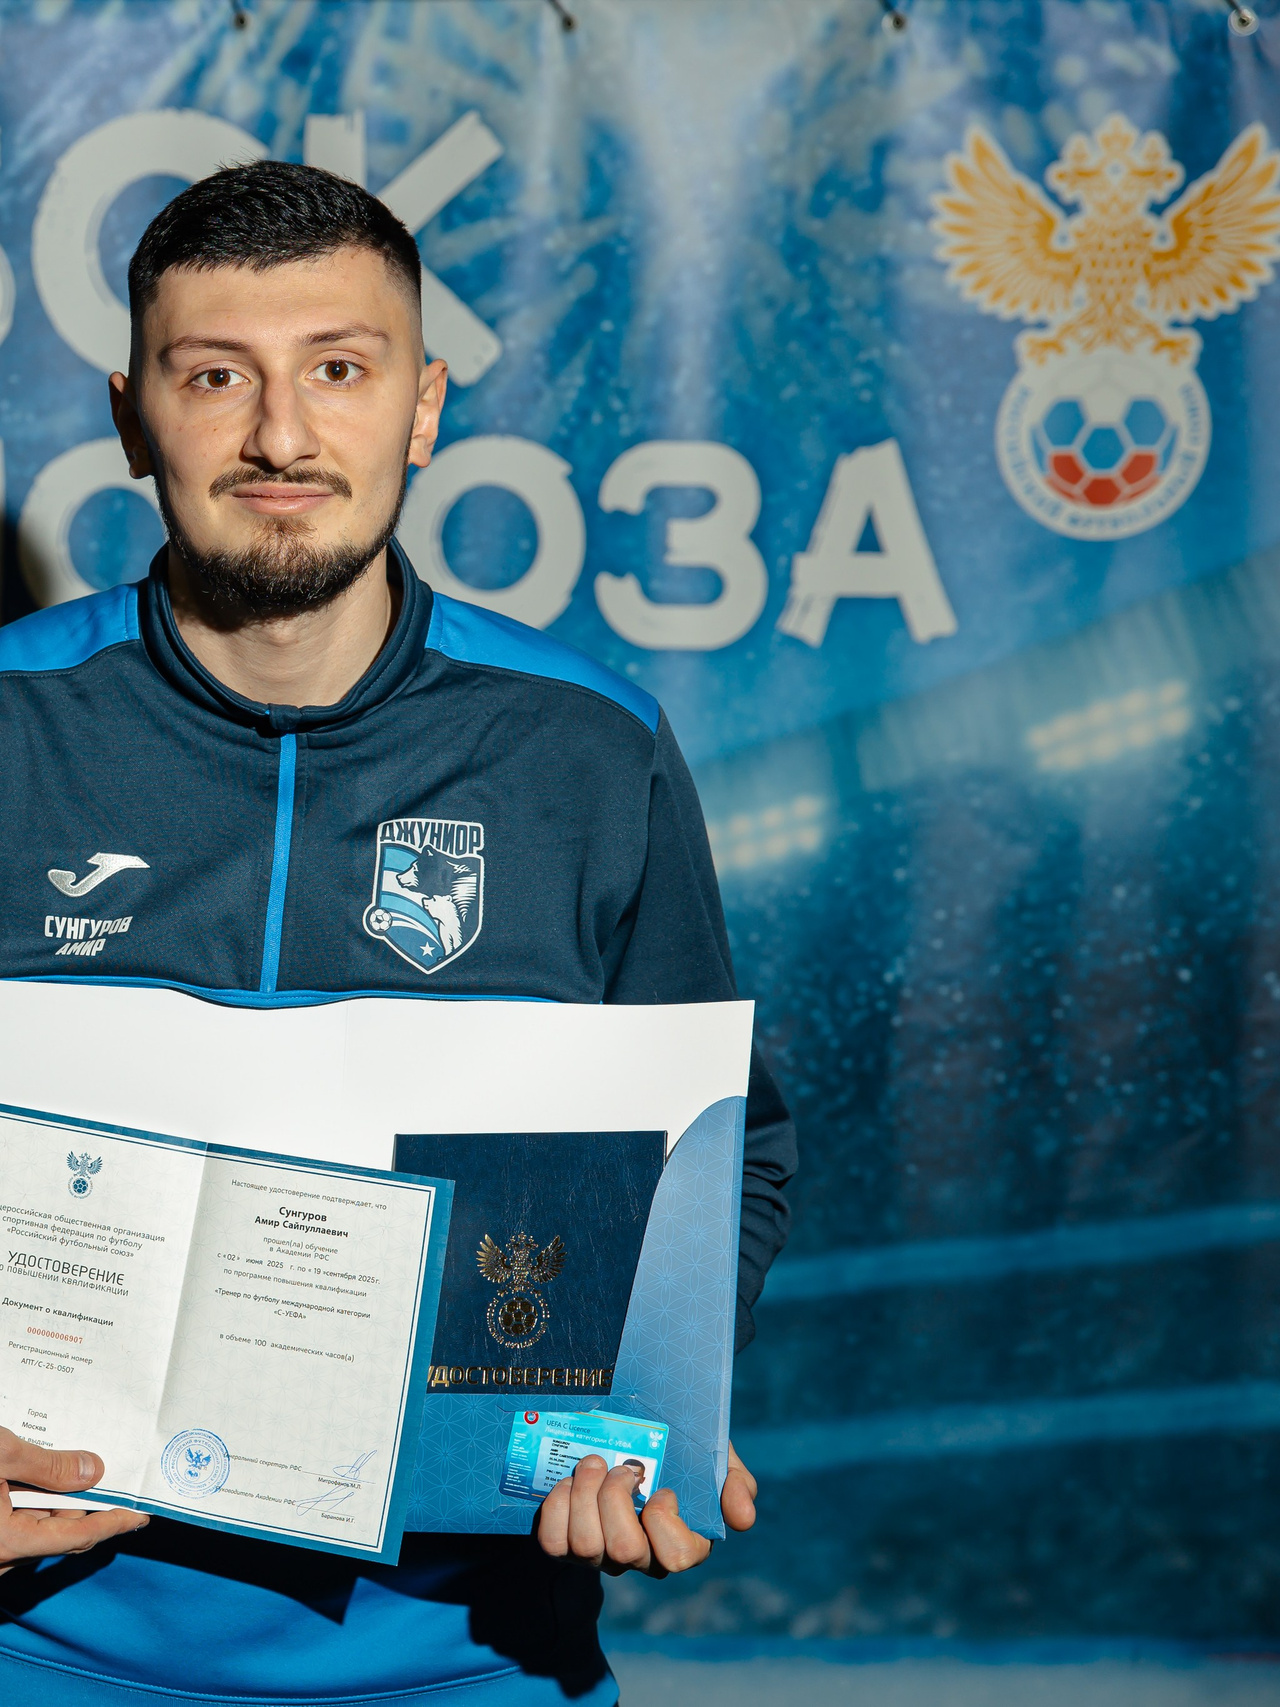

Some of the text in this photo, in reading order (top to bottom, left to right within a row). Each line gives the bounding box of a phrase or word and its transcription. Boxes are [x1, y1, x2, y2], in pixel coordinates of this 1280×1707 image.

[380, 821, 481, 857] ДЖУНИОР
[44, 915, 133, 940] СУНГУРОВ
[54, 938, 106, 957] АМИР
[231, 1179, 268, 1191] Настоящее
[269, 1186, 321, 1199] удостоверение
[322, 1194, 373, 1209] подтверждает,
[279, 1206, 327, 1222] Сунгуров
[2, 1215, 143, 1251] спортивная федерация по футболу
[54, 1214, 112, 1232] общественная
[113, 1226, 166, 1243] организация
[254, 1215, 349, 1238] Амир Сайпуллаевич
[7, 1226, 135, 1258] «Российский футбольный союз»
[263, 1236, 339, 1255] прошел(ла) обучение
[276, 1246, 312, 1258] Академии
[313, 1252, 330, 1261] РФС
[8, 1250, 125, 1286] УДОСТОВЕРЕНИЕ
[267, 1260, 284, 1269] 2025
[6, 1265, 60, 1282] ПОВЫШЕНИИ
[61, 1276, 129, 1297] КВАЛИФИКАЦИИ
[233, 1270, 272, 1282] программе
[273, 1276, 314, 1289] повышения
[315, 1283, 367, 1298] квалификации
[2, 1297, 44, 1312] Документ
[53, 1309, 114, 1327] квалификации
[215, 1287, 242, 1298] «Тренер
[253, 1294, 280, 1305] футболу
[281, 1299, 335, 1313] международной
[336, 1308, 371, 1319] категории
[273, 1308, 307, 1319] «С-УЕФА»
[27, 1326, 84, 1344] 000000006907
[8, 1340, 93, 1365] Регистрационный номер
[225, 1333, 251, 1344] объеме
[254, 1338, 267, 1347] 100
[270, 1343, 324, 1356] академических
[325, 1351, 355, 1362] часов(а)
[21, 1357, 75, 1374] АПТ/С-25-0507
[27, 1408, 48, 1419] Город
[22, 1421, 47, 1432] Москва
[546, 1419, 591, 1434] UEFA C Licence
[575, 1433, 607, 1444] категории
[289, 1464, 303, 1472] РФС
[255, 1493, 282, 1503] Академии
